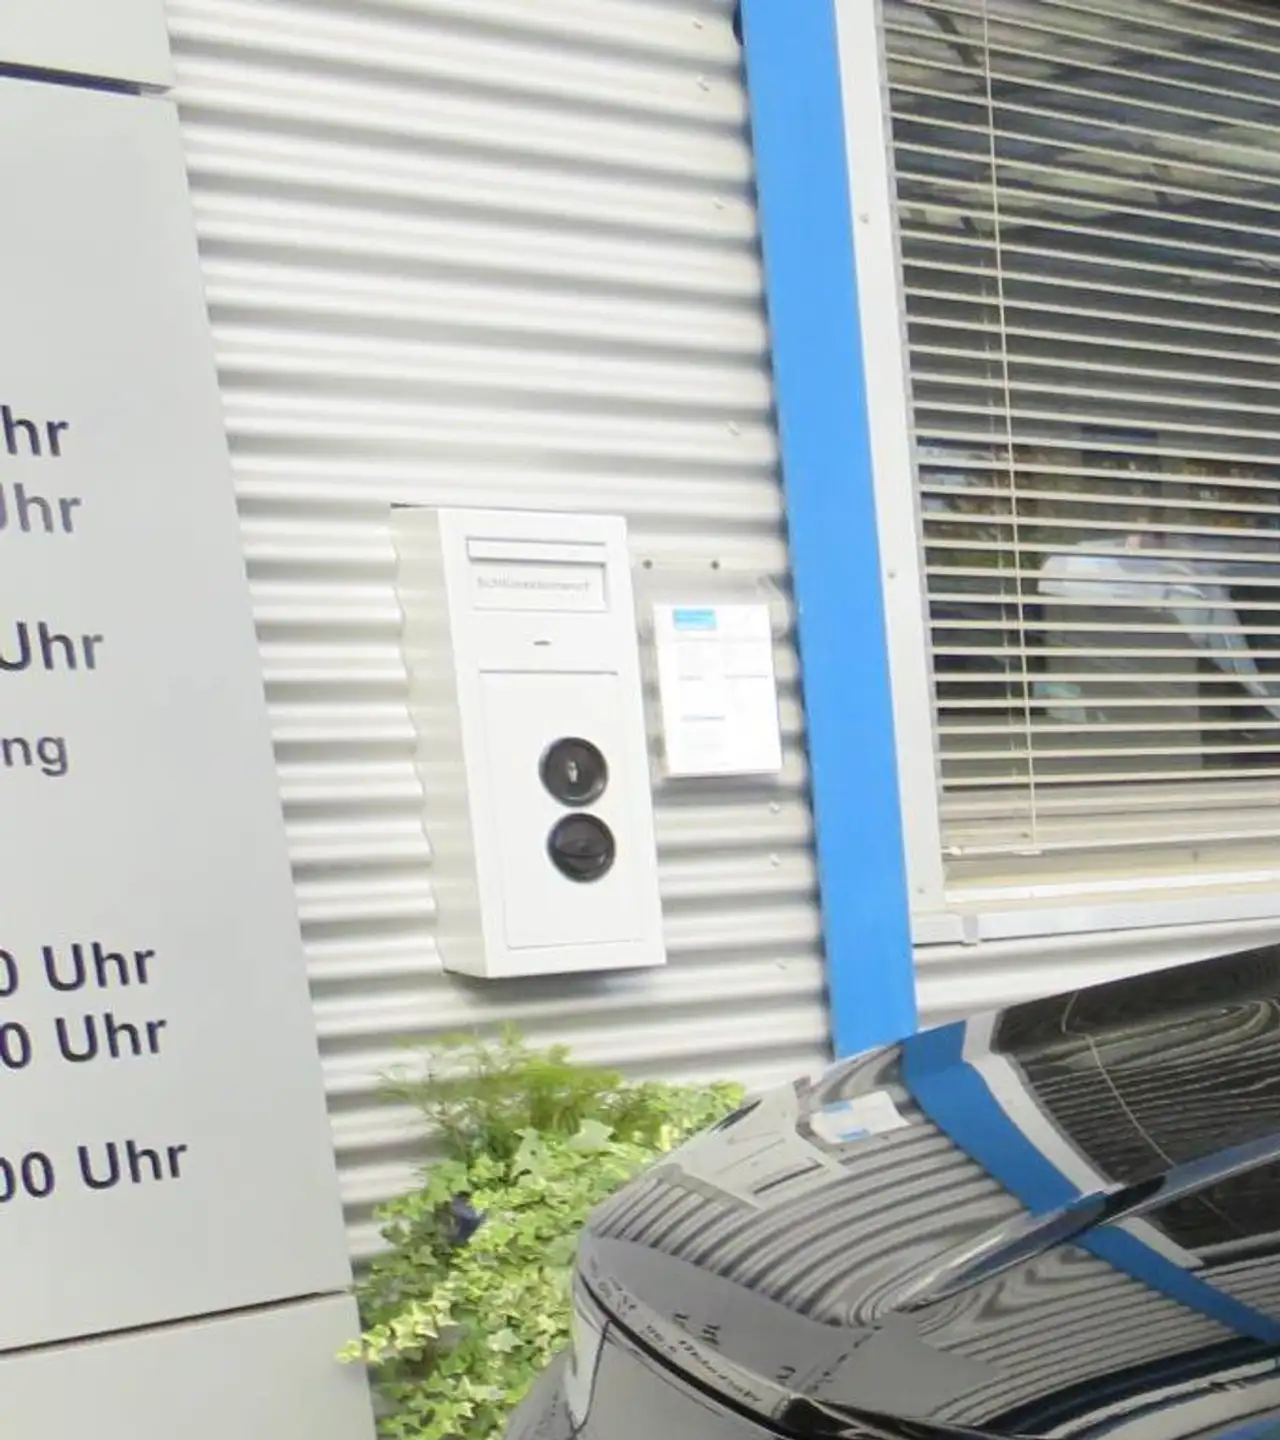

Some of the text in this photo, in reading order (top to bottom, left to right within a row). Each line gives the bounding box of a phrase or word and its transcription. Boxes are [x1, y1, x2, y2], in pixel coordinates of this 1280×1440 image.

[0, 404, 69, 457] hr
[0, 482, 82, 534] hr
[41, 941, 156, 992] Uhr
[54, 1012, 167, 1063] Uhr
[77, 1139, 188, 1190] Uhr
